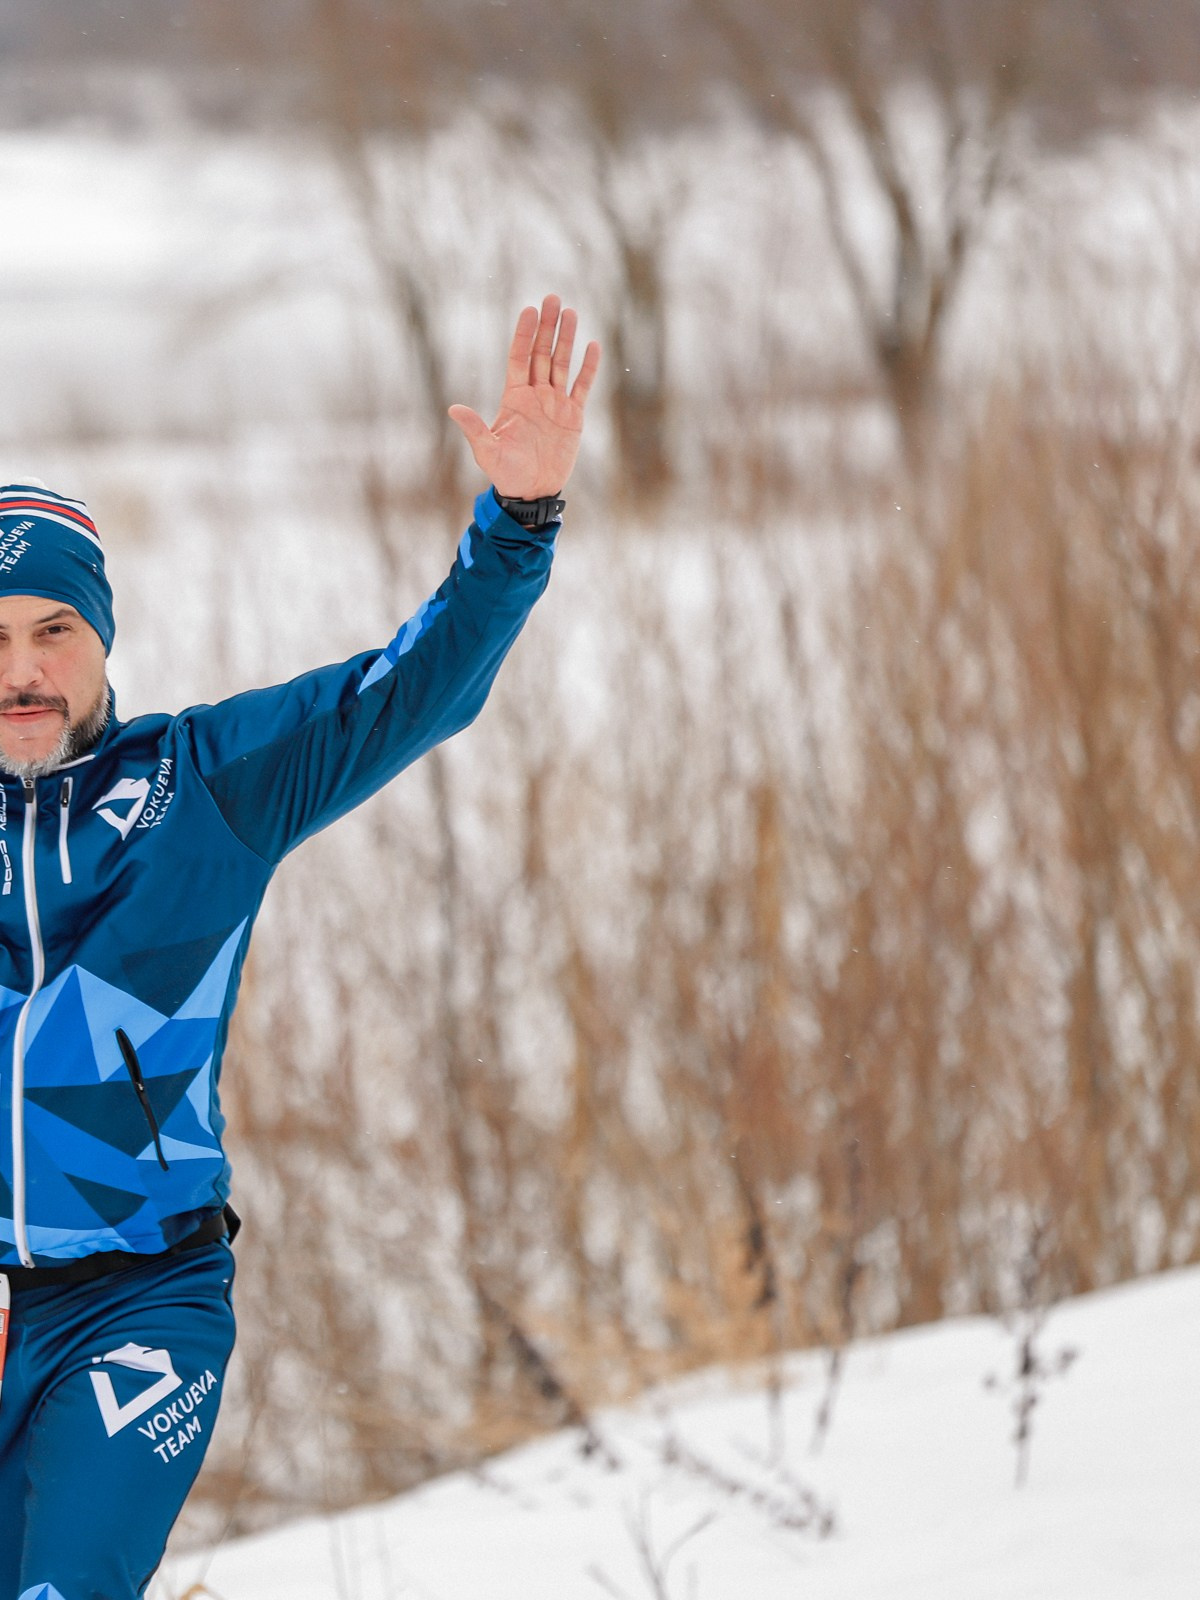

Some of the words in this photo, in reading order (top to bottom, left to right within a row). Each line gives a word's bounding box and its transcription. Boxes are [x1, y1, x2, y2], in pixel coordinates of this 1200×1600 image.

[0, 540, 32, 571] TEAM
[136, 758, 174, 829] VOKUEVA
[137, 1369, 218, 1441] VOKUEVA
[153, 1415, 202, 1464] TEAM
